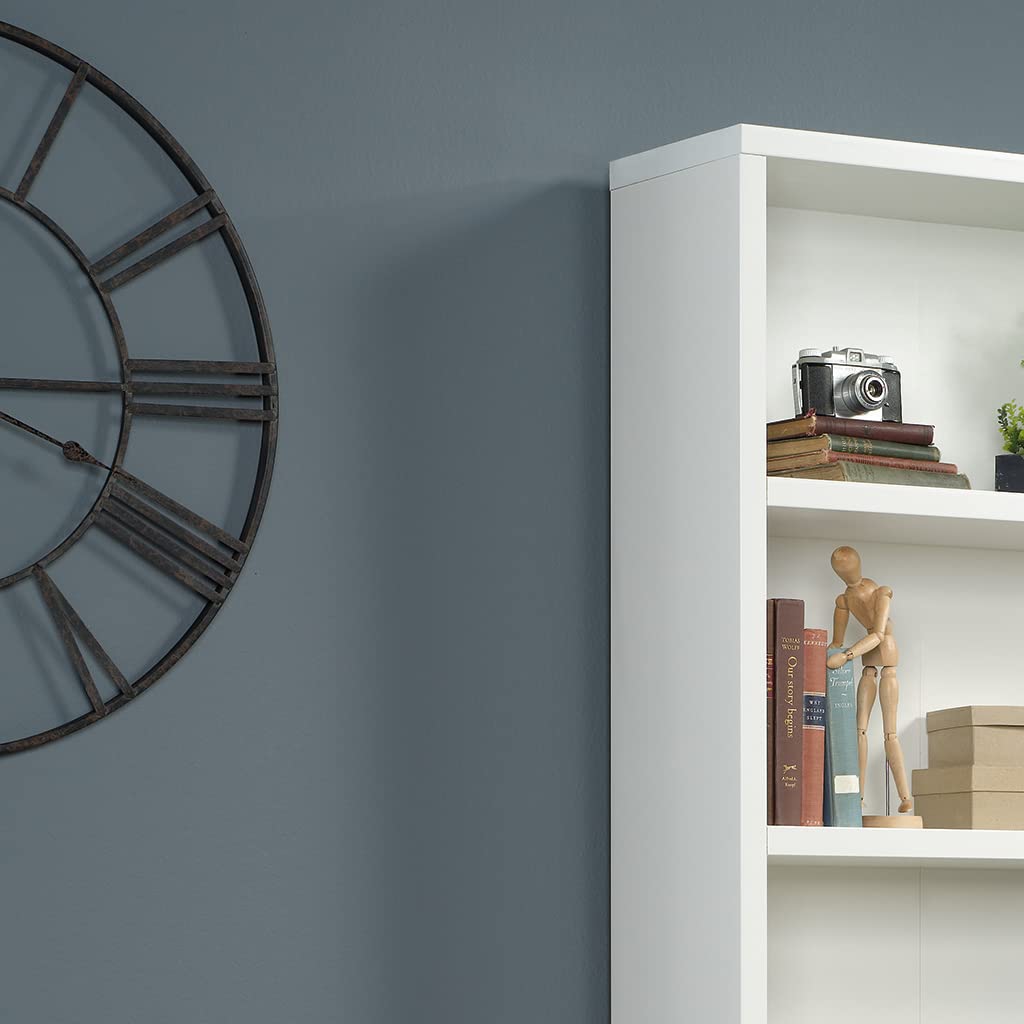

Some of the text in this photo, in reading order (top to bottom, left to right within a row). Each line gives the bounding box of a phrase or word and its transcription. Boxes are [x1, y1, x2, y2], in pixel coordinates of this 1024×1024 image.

[784, 656, 798, 738] Our story begins
